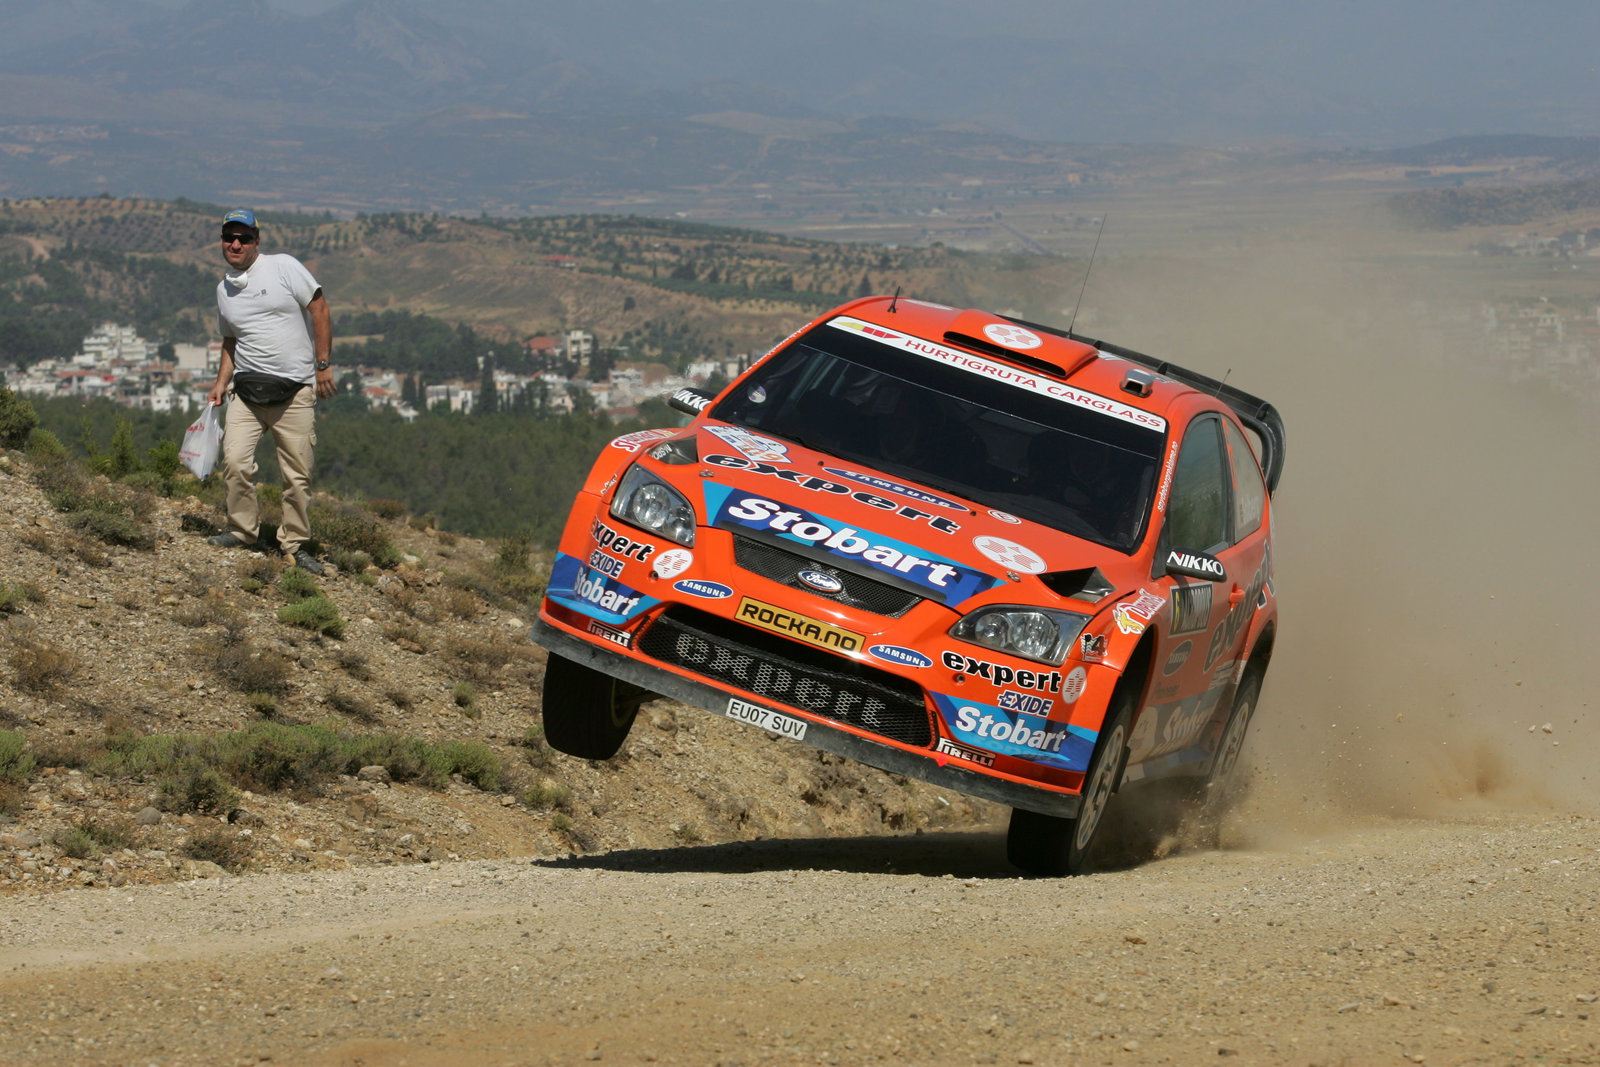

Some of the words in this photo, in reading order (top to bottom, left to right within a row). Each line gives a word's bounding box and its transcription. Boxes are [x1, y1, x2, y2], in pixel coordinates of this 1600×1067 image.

[905, 339, 1037, 388] HURTIGRUTA
[1046, 385, 1161, 428] CARGLASS
[703, 454, 962, 535] expert
[844, 470, 952, 508] SAMSUNG
[728, 497, 956, 587] Stobart
[589, 549, 625, 579] EXIDE
[1166, 551, 1224, 576] NIKKO
[575, 566, 640, 616] Stobart
[682, 580, 726, 598] SAMSUNG
[587, 619, 631, 647] PIRELLI
[878, 645, 926, 667] SAMSUNG
[941, 650, 1063, 693] expert
[676, 633, 886, 728] expert
[728, 701, 771, 725] EU07
[771, 715, 805, 738] SUV
[997, 690, 1054, 717] EXIDE
[955, 706, 1067, 752] Stobart
[936, 737, 997, 767] PIRELLI
